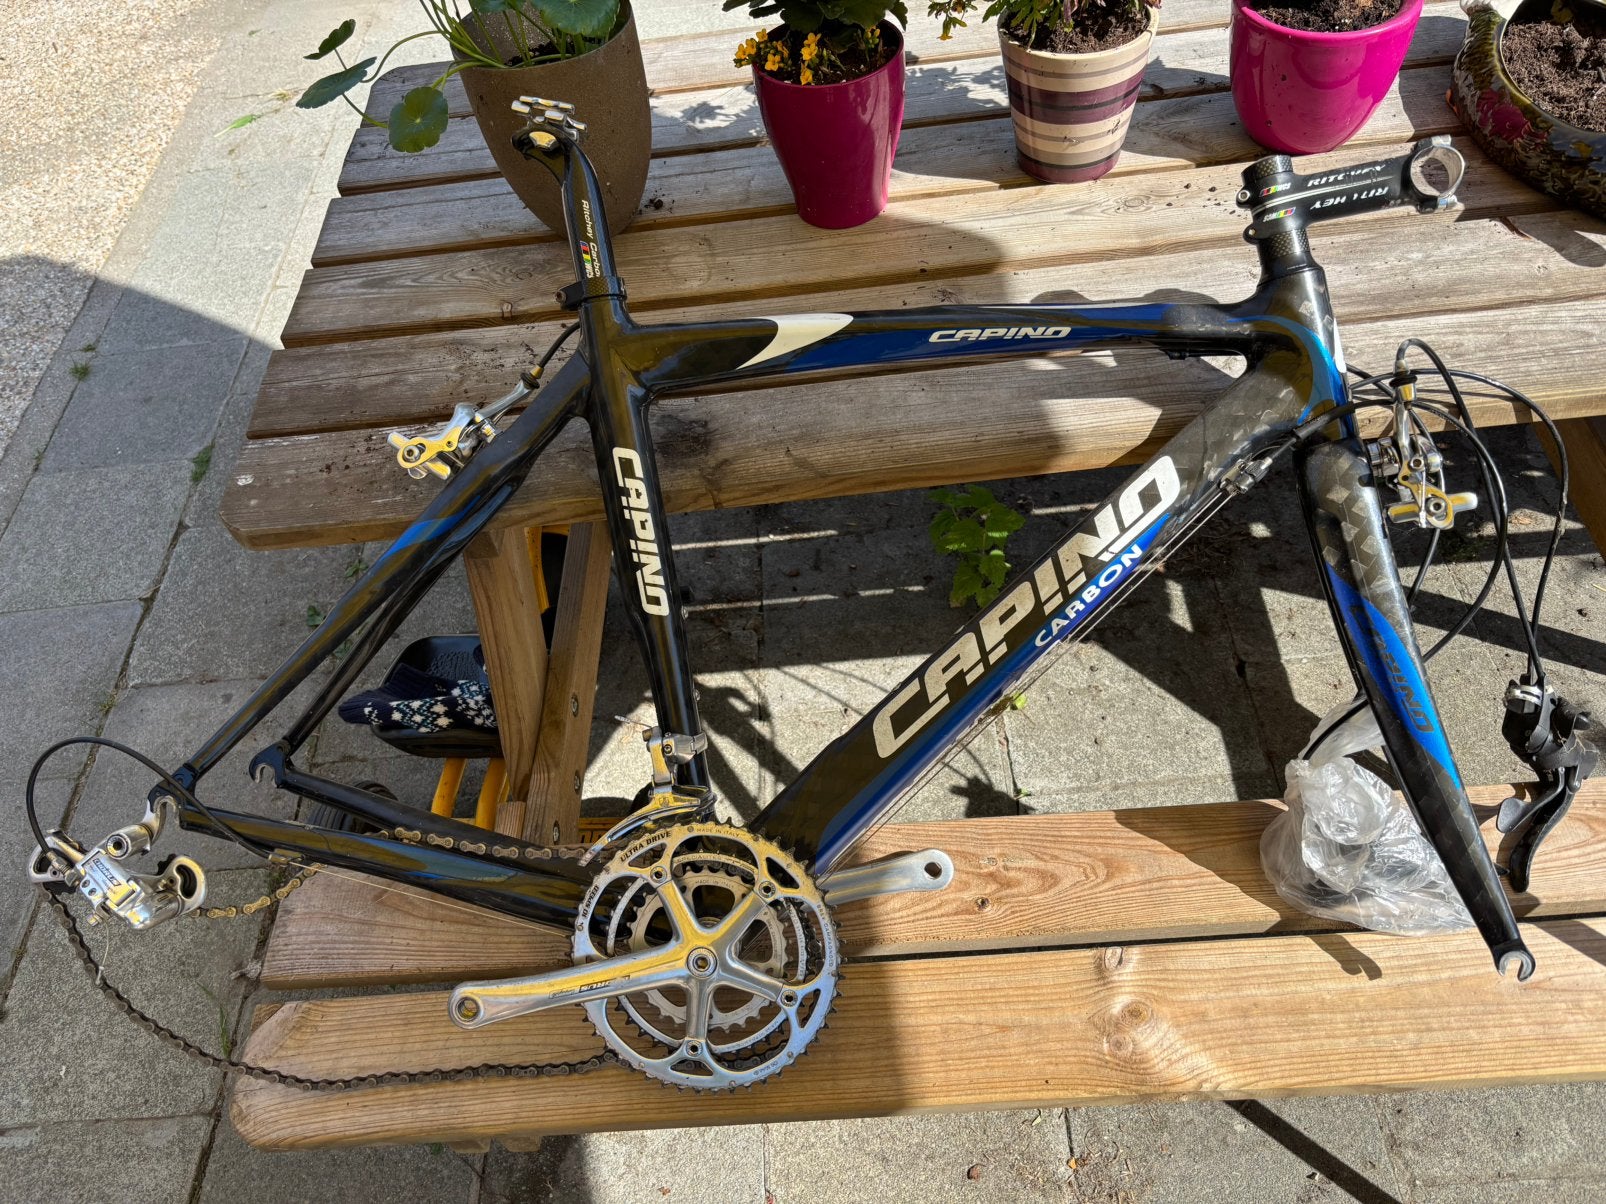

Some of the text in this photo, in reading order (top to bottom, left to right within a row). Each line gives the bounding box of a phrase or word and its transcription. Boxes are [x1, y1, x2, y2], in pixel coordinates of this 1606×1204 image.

[581, 199, 601, 277] Ritchey Carbo
[928, 326, 1072, 343] CAPINO
[612, 446, 670, 617] CAPINO
[872, 455, 1181, 759] CAPINO
[1034, 543, 1143, 647] CARBON
[1349, 604, 1435, 733] CAPINO
[620, 829, 672, 862] ULTRA DRIVE
[585, 884, 600, 909] SPEED
